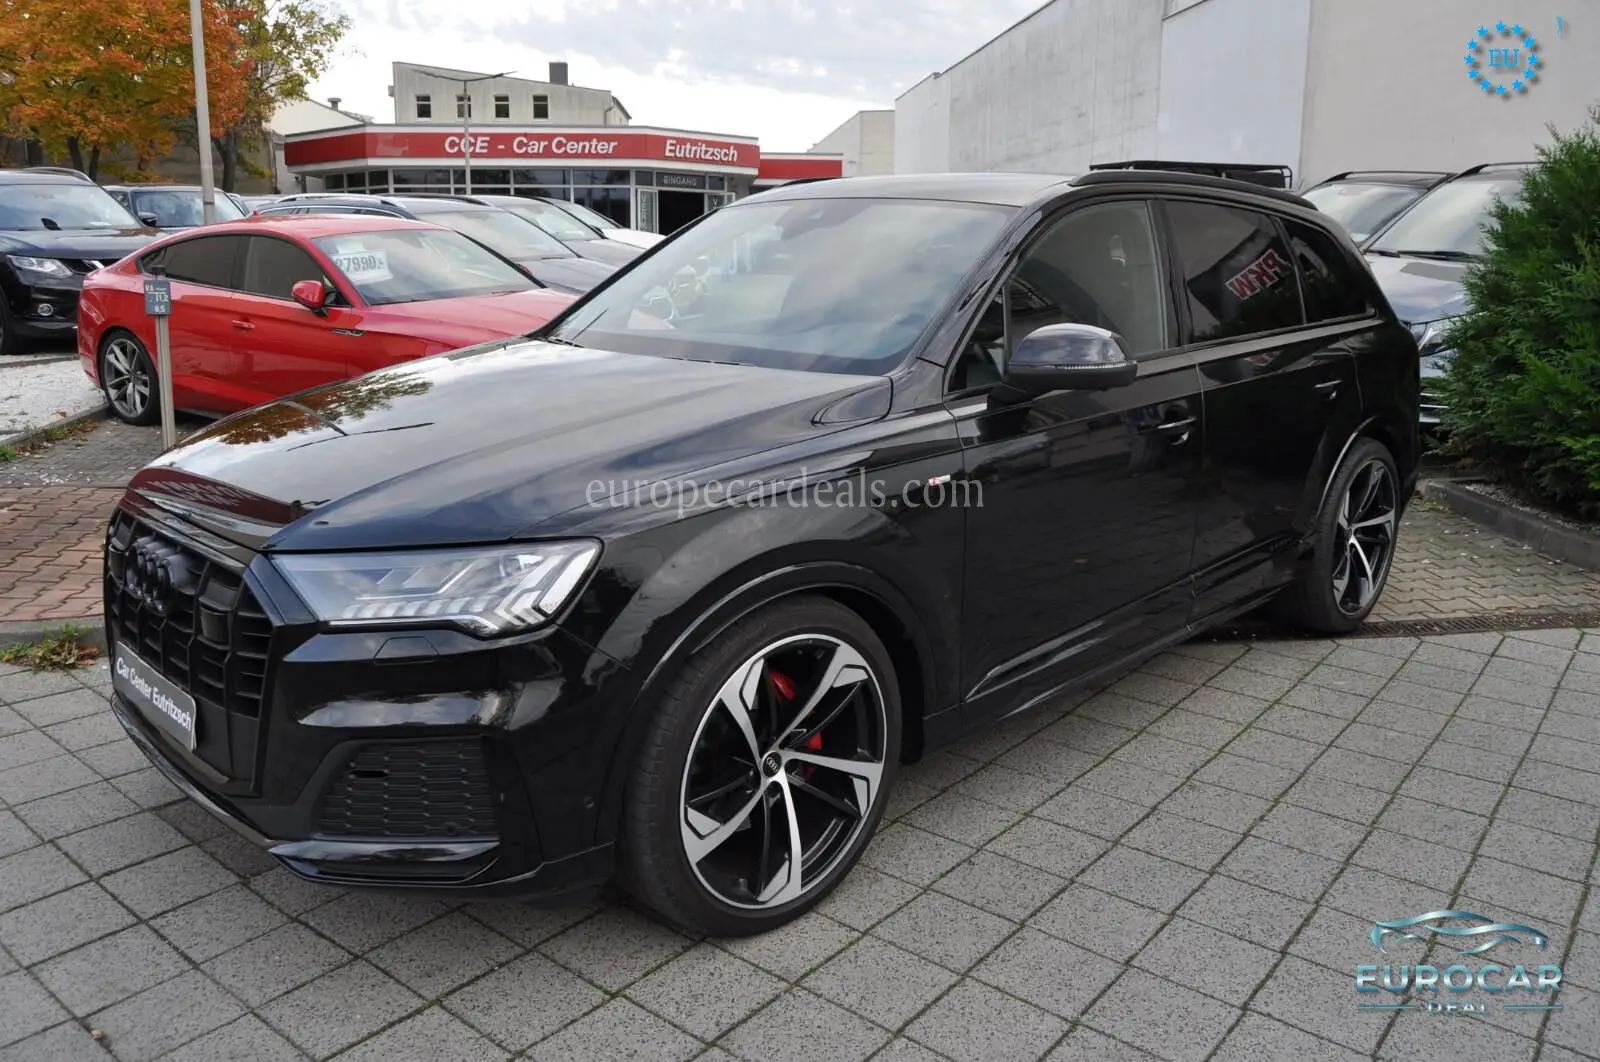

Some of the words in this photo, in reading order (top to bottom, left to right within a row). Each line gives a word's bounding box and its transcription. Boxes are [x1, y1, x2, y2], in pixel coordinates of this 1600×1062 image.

[444, 136, 490, 154] CCE
[512, 136, 548, 154] Car
[551, 136, 618, 154] Center
[664, 139, 738, 162] Eutritzsch
[663, 175, 698, 186] EINGANG
[116, 657, 130, 679] Car
[129, 668, 152, 699] Center
[152, 687, 192, 732] Eutritzsch
